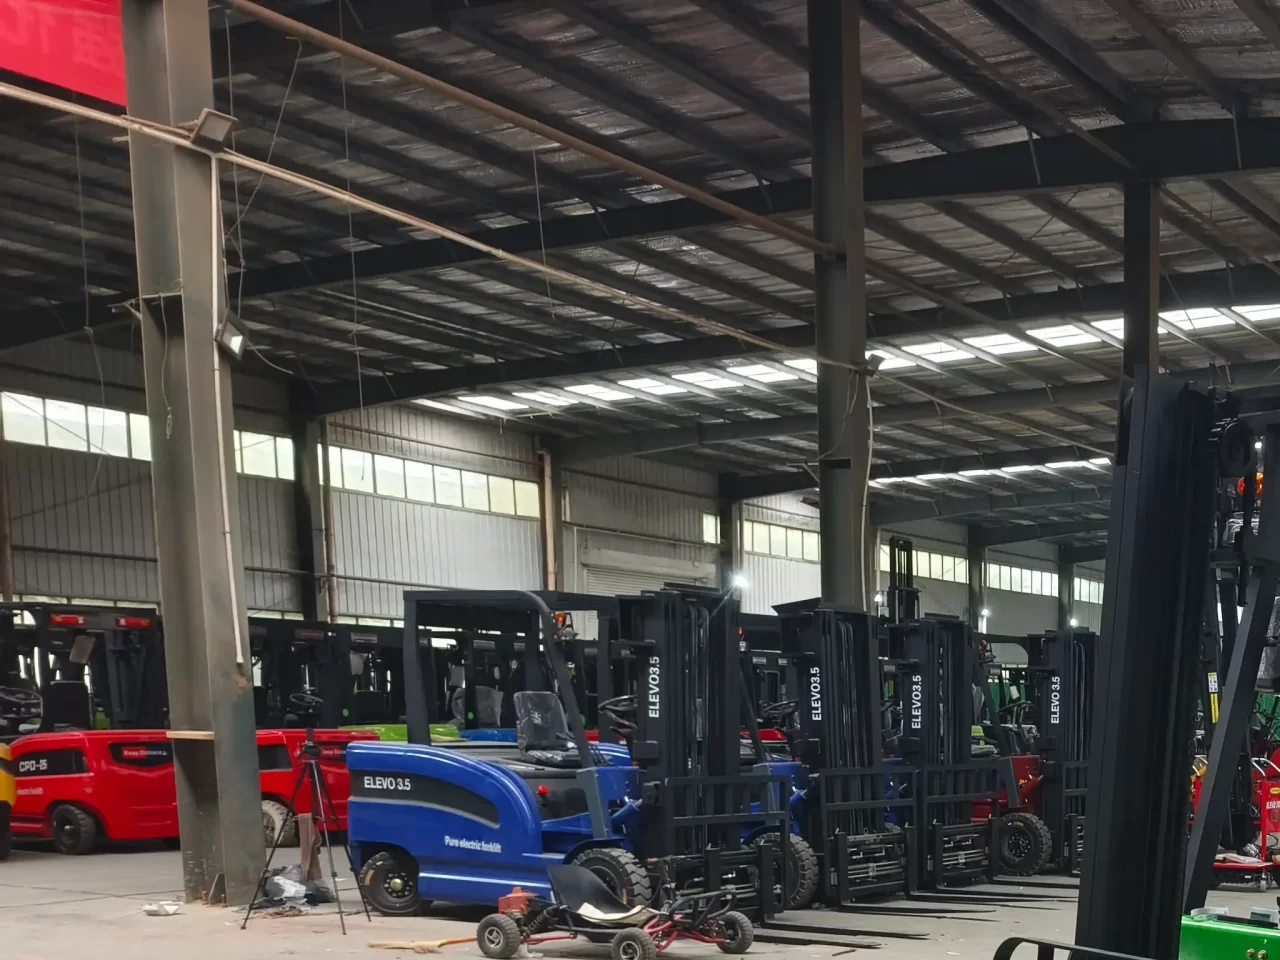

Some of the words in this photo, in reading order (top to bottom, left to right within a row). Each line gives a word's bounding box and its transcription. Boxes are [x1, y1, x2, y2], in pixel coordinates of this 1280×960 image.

[649, 656, 660, 718] ELEVO3.5
[810, 667, 822, 721] ELEVO3.5
[1051, 676, 1061, 693] 3.5
[911, 675, 922, 729] ELEVO3.5
[1050, 693, 1060, 724] ELEVO
[364, 776, 396, 790] ELEVO
[397, 778, 411, 791] 3.5
[444, 835, 459, 847] Pure
[460, 838, 481, 850] electric
